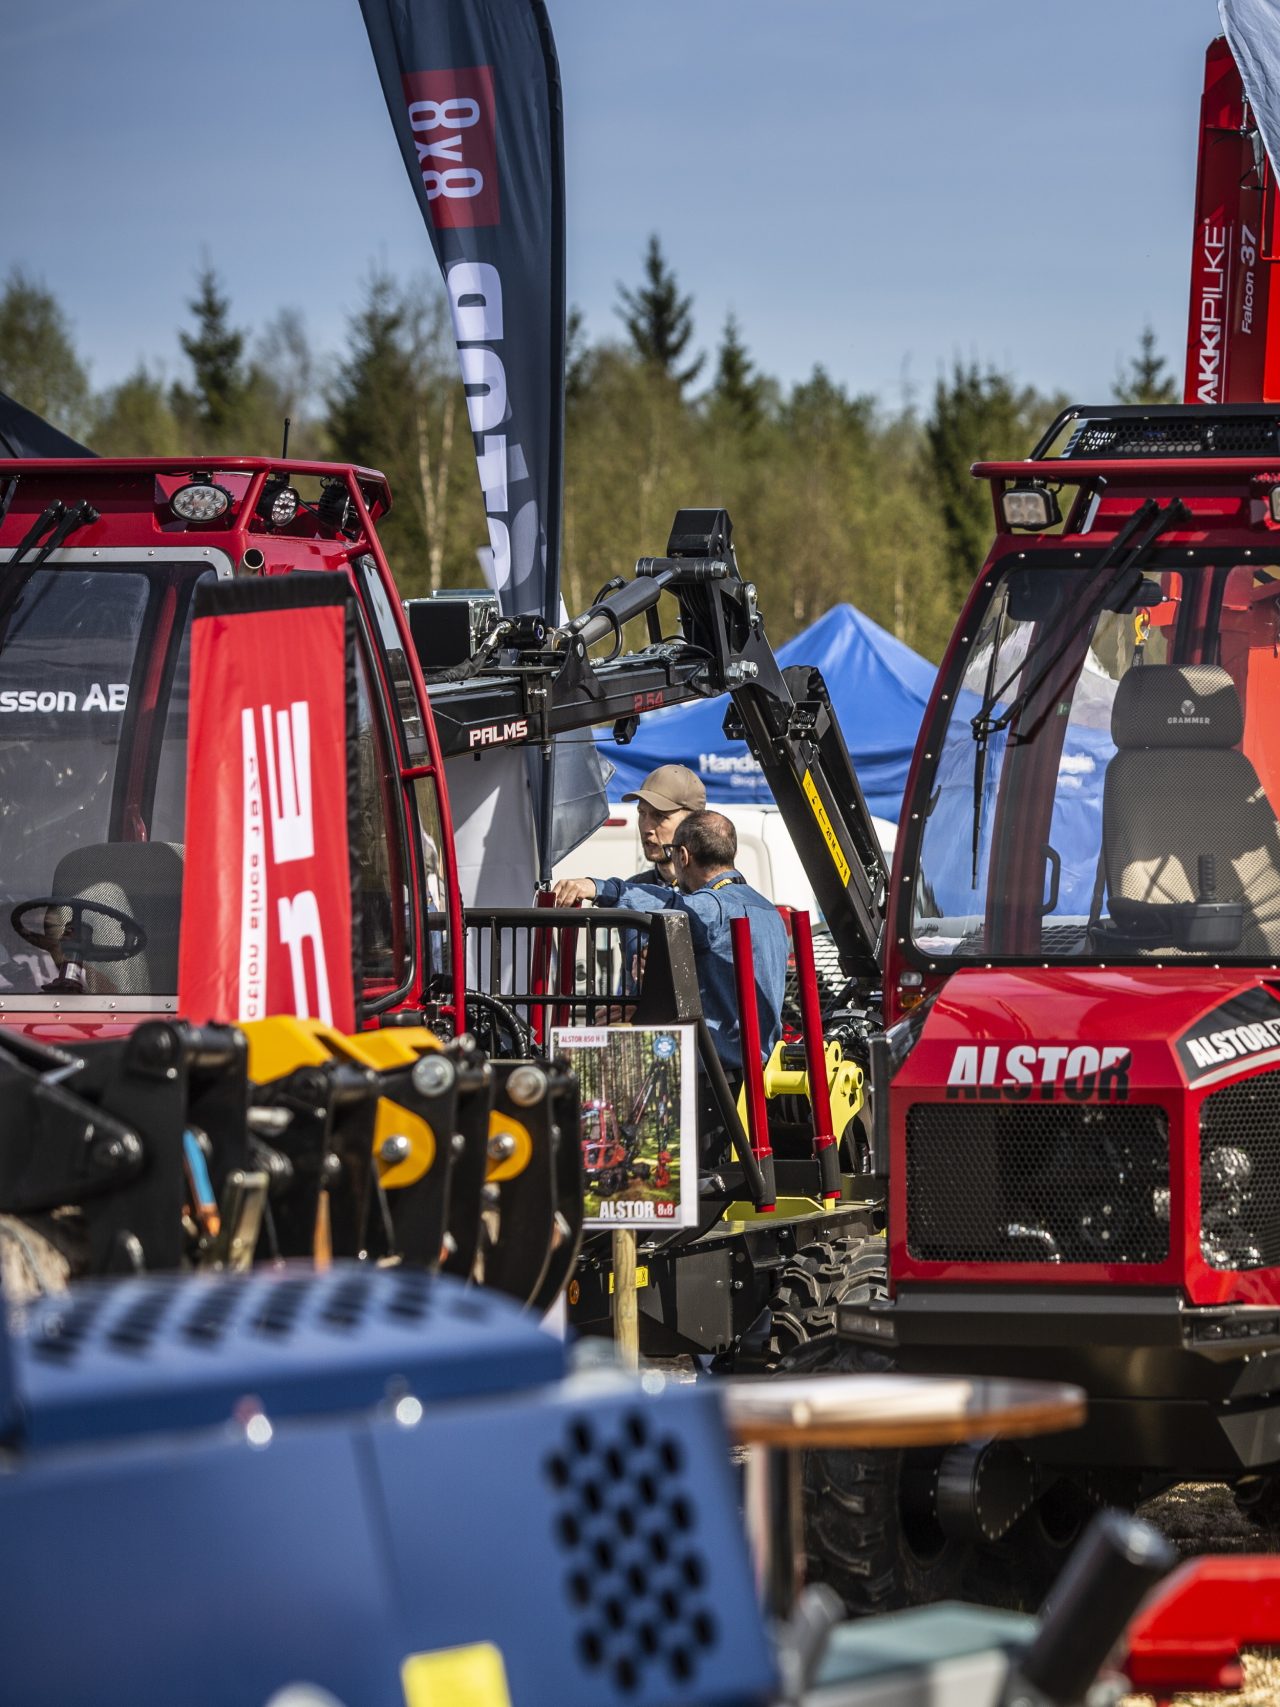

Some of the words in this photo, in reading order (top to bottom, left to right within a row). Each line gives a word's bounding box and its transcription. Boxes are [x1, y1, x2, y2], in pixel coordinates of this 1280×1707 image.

[1240, 224, 1256, 267] 37
[1241, 271, 1255, 334] Falcon
[81, 683, 129, 712] AB
[469, 720, 528, 747] PALMS
[1167, 717, 1210, 725] GRAMMER
[1185, 1022, 1278, 1068] ALSTOR
[945, 1046, 1132, 1101] ALSTOR
[600, 1201, 656, 1218] ALSTOR
